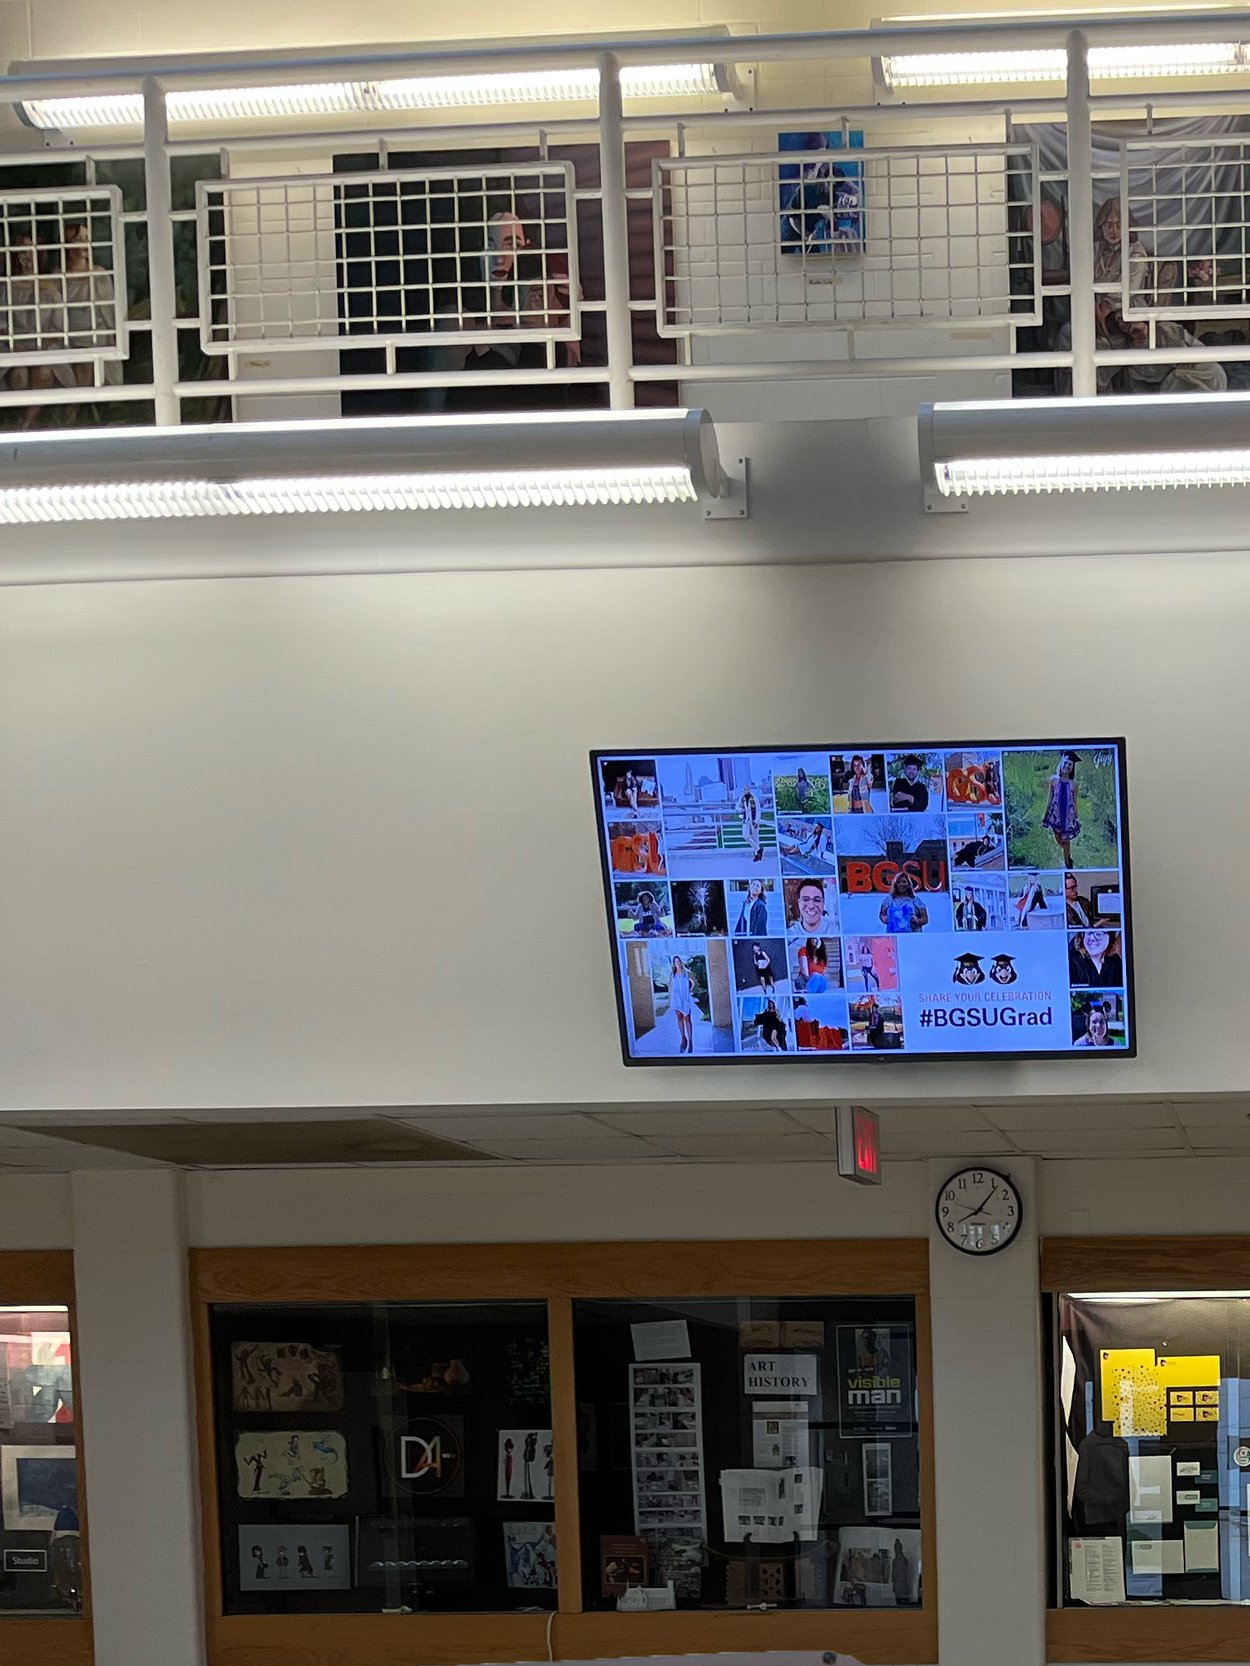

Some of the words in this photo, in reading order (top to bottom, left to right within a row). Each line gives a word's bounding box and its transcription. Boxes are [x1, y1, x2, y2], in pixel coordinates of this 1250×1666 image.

[918, 993, 952, 1003] SHARE
[955, 992, 981, 1003] YOUR
[984, 991, 1051, 1002] CELEBRATION
[919, 1006, 1052, 1028] #BGSUGrad
[958, 1179, 967, 1189] 11
[972, 1173, 984, 1184] 12
[944, 1190, 955, 1201] 10
[1002, 1189, 1009, 1200] 2
[942, 1206, 949, 1218] 9
[1007, 1205, 1014, 1217] 3
[947, 1221, 955, 1233] 8
[960, 1234, 968, 1246] 7
[975, 1238, 983, 1249] 6
[991, 1234, 998, 1245] 5
[750, 1361, 776, 1371] ART
[749, 1376, 809, 1387] HISTORY
[848, 1375, 900, 1389] visible
[848, 1389, 901, 1404] man
